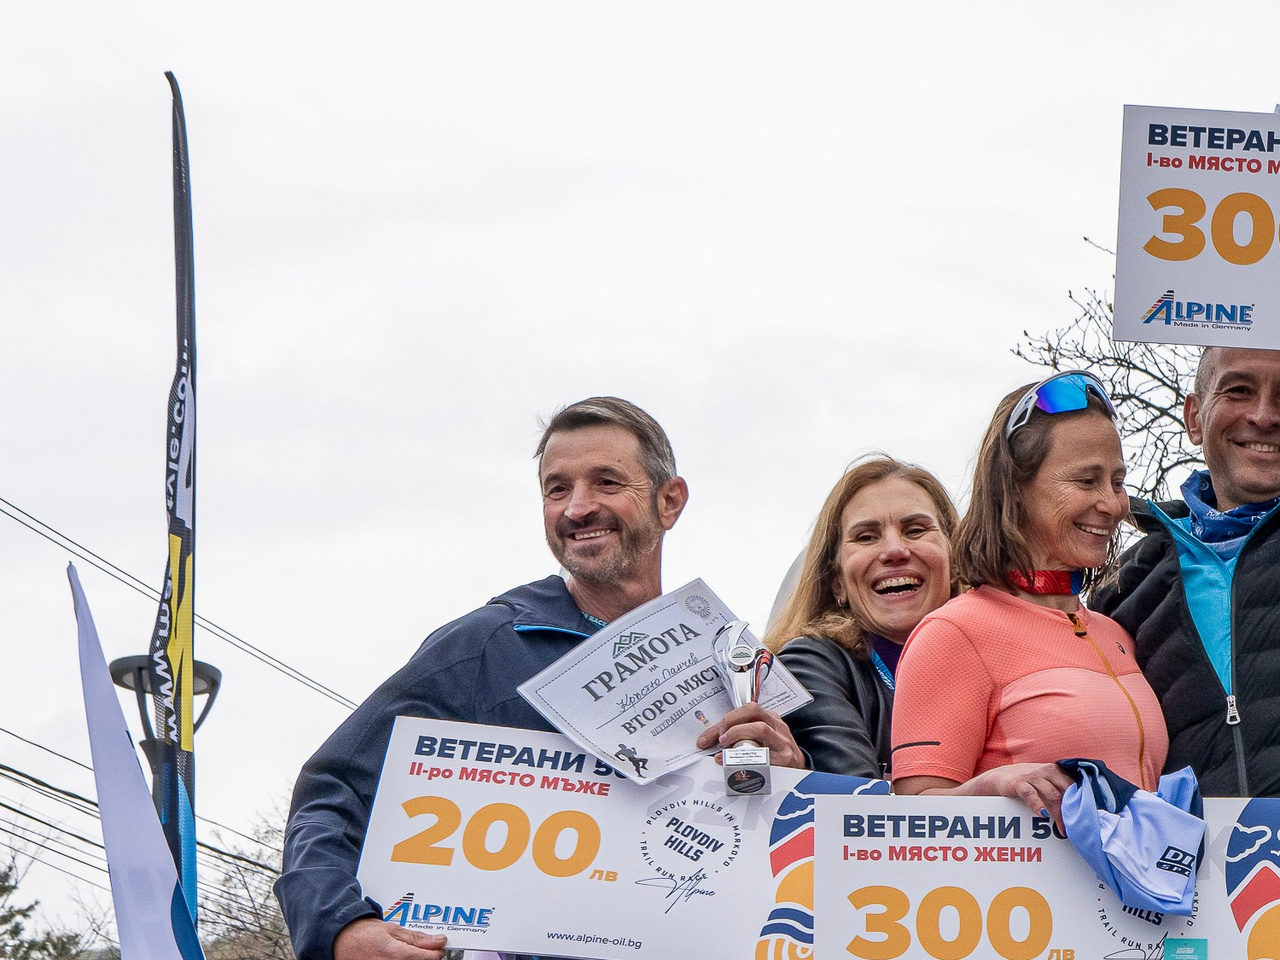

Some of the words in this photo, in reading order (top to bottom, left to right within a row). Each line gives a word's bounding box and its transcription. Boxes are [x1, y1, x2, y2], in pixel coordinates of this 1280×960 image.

[1187, 156, 1263, 174] МЯСТО
[1141, 290, 1254, 326] ALPINE
[1211, 324, 1252, 332] Germany
[581, 621, 702, 702] ГРАМОТА
[648, 664, 660, 673] НА
[620, 690, 678, 736] ВТОРО
[675, 664, 720, 699] МЯСТ
[650, 708, 686, 738] ВЕТЕРАНИ
[414, 735, 587, 776] ВЕТЕРАНИ
[459, 766, 536, 788] МЯСТО
[540, 774, 611, 797] МЪЖЕ
[646, 800, 687, 826] PLOVDIV
[692, 799, 723, 813] HILLS
[724, 812, 735, 822] IN
[390, 795, 601, 878] 200
[588, 868, 618, 884] лв
[665, 816, 725, 853] PLOVDIV
[842, 814, 1021, 840] ВЕТЕРАНИ
[640, 840, 655, 866] TRAIL
[655, 866, 675, 880] RUN
[663, 835, 704, 862] HILLS
[723, 825, 742, 867] MARKOVO
[888, 845, 970, 863] МЯСТО
[974, 845, 1042, 863] ЖЕНИ
[1164, 848, 1196, 868] DI
[383, 893, 495, 927] ALPINE
[447, 925, 488, 934] Germany
[547, 931, 643, 949] www.alpine-oil.bg
[1097, 907, 1117, 938] TRAIL
[1120, 936, 1142, 950] RUN
